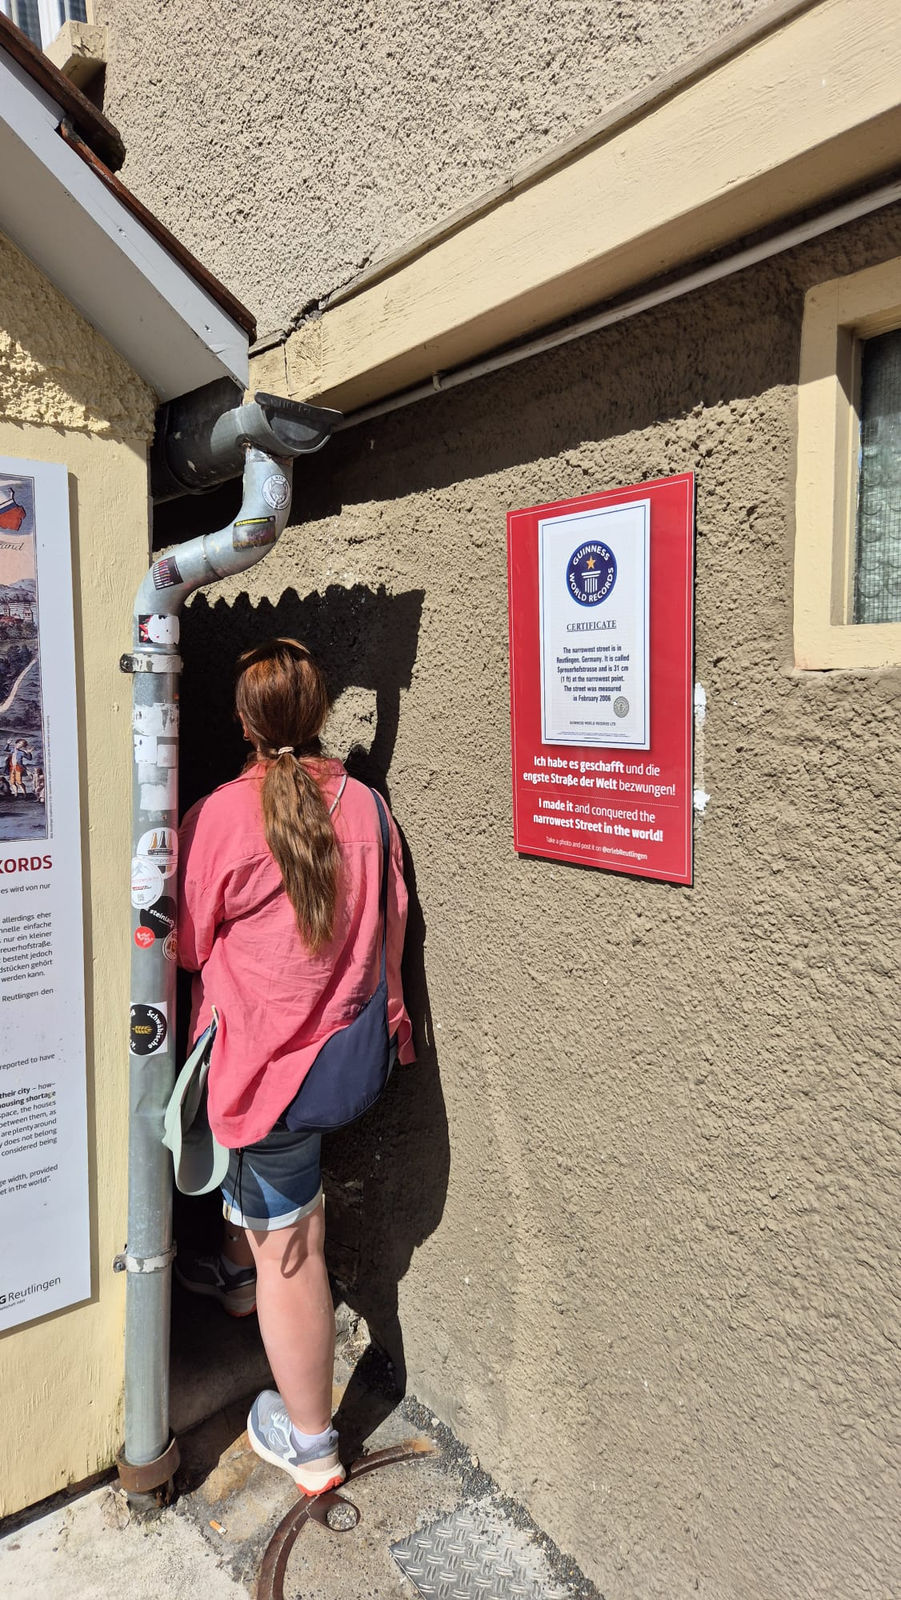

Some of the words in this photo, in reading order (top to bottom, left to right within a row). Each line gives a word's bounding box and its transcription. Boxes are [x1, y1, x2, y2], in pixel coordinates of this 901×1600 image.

[572, 544, 610, 566] GUINNESS
[570, 572, 587, 602] WORLD
[588, 567, 614, 602] RECORDS
[566, 620, 617, 631] CERTIFICATE
[611, 644, 616, 652] is
[617, 644, 622, 652] in
[582, 656, 604, 664] Germany.
[614, 654, 630, 662] called
[614, 664, 620, 672] 31
[611, 674, 624, 683] point.
[578, 694, 598, 703] February
[534, 756, 546, 767] Ich
[547, 757, 568, 769] habe
[569, 760, 579, 770] es
[580, 760, 625, 774] geschafft
[625, 763, 644, 775] und
[645, 764, 661, 776] die
[523, 772, 550, 784] engste
[550, 773, 578, 787] Straße
[579, 776, 595, 788] der
[596, 777, 618, 790] Welt
[619, 780, 676, 798] bezwungen!
[538, 798, 542, 808] I
[543, 799, 566, 811] made
[566, 800, 574, 812] it
[574, 804, 590, 814] and
[591, 805, 638, 821] conquered
[640, 810, 656, 823] the
[533, 814, 574, 829] narrowest
[575, 819, 602, 832] Street
[603, 822, 613, 834] in
[614, 824, 630, 837] the
[632, 828, 664, 842] world!
[559, 839, 572, 848] photo
[580, 843, 591, 851] post
[2, 915, 34, 924] allerdings
[24, 922, 52, 930] einfache
[3, 954, 29, 963] besteht
[30, 950, 52, 960] jedoch
[31, 959, 53, 970] gehört
[1, 974, 26, 982] werden
[2, 991, 38, 1002] Reutlingen
[146, 1009, 164, 1049] Schwäbische
[18, 1087, 31, 1095] city
[26, 1091, 56, 1102] shortage
[33, 1100, 56, 1110] houses
[12, 1124, 33, 1136] plenty
[34, 1118, 56, 1128] around
[4, 1138, 20, 1146] does
[22, 1133, 33, 1141] not
[34, 1128, 57, 1138] belong
[1, 1142, 38, 1156] considered
[40, 1137, 57, 1147] being
[30, 1163, 58, 1178] provided
[16, 1183, 27, 1191] the
[8, 1277, 61, 1302] Reutlingen
